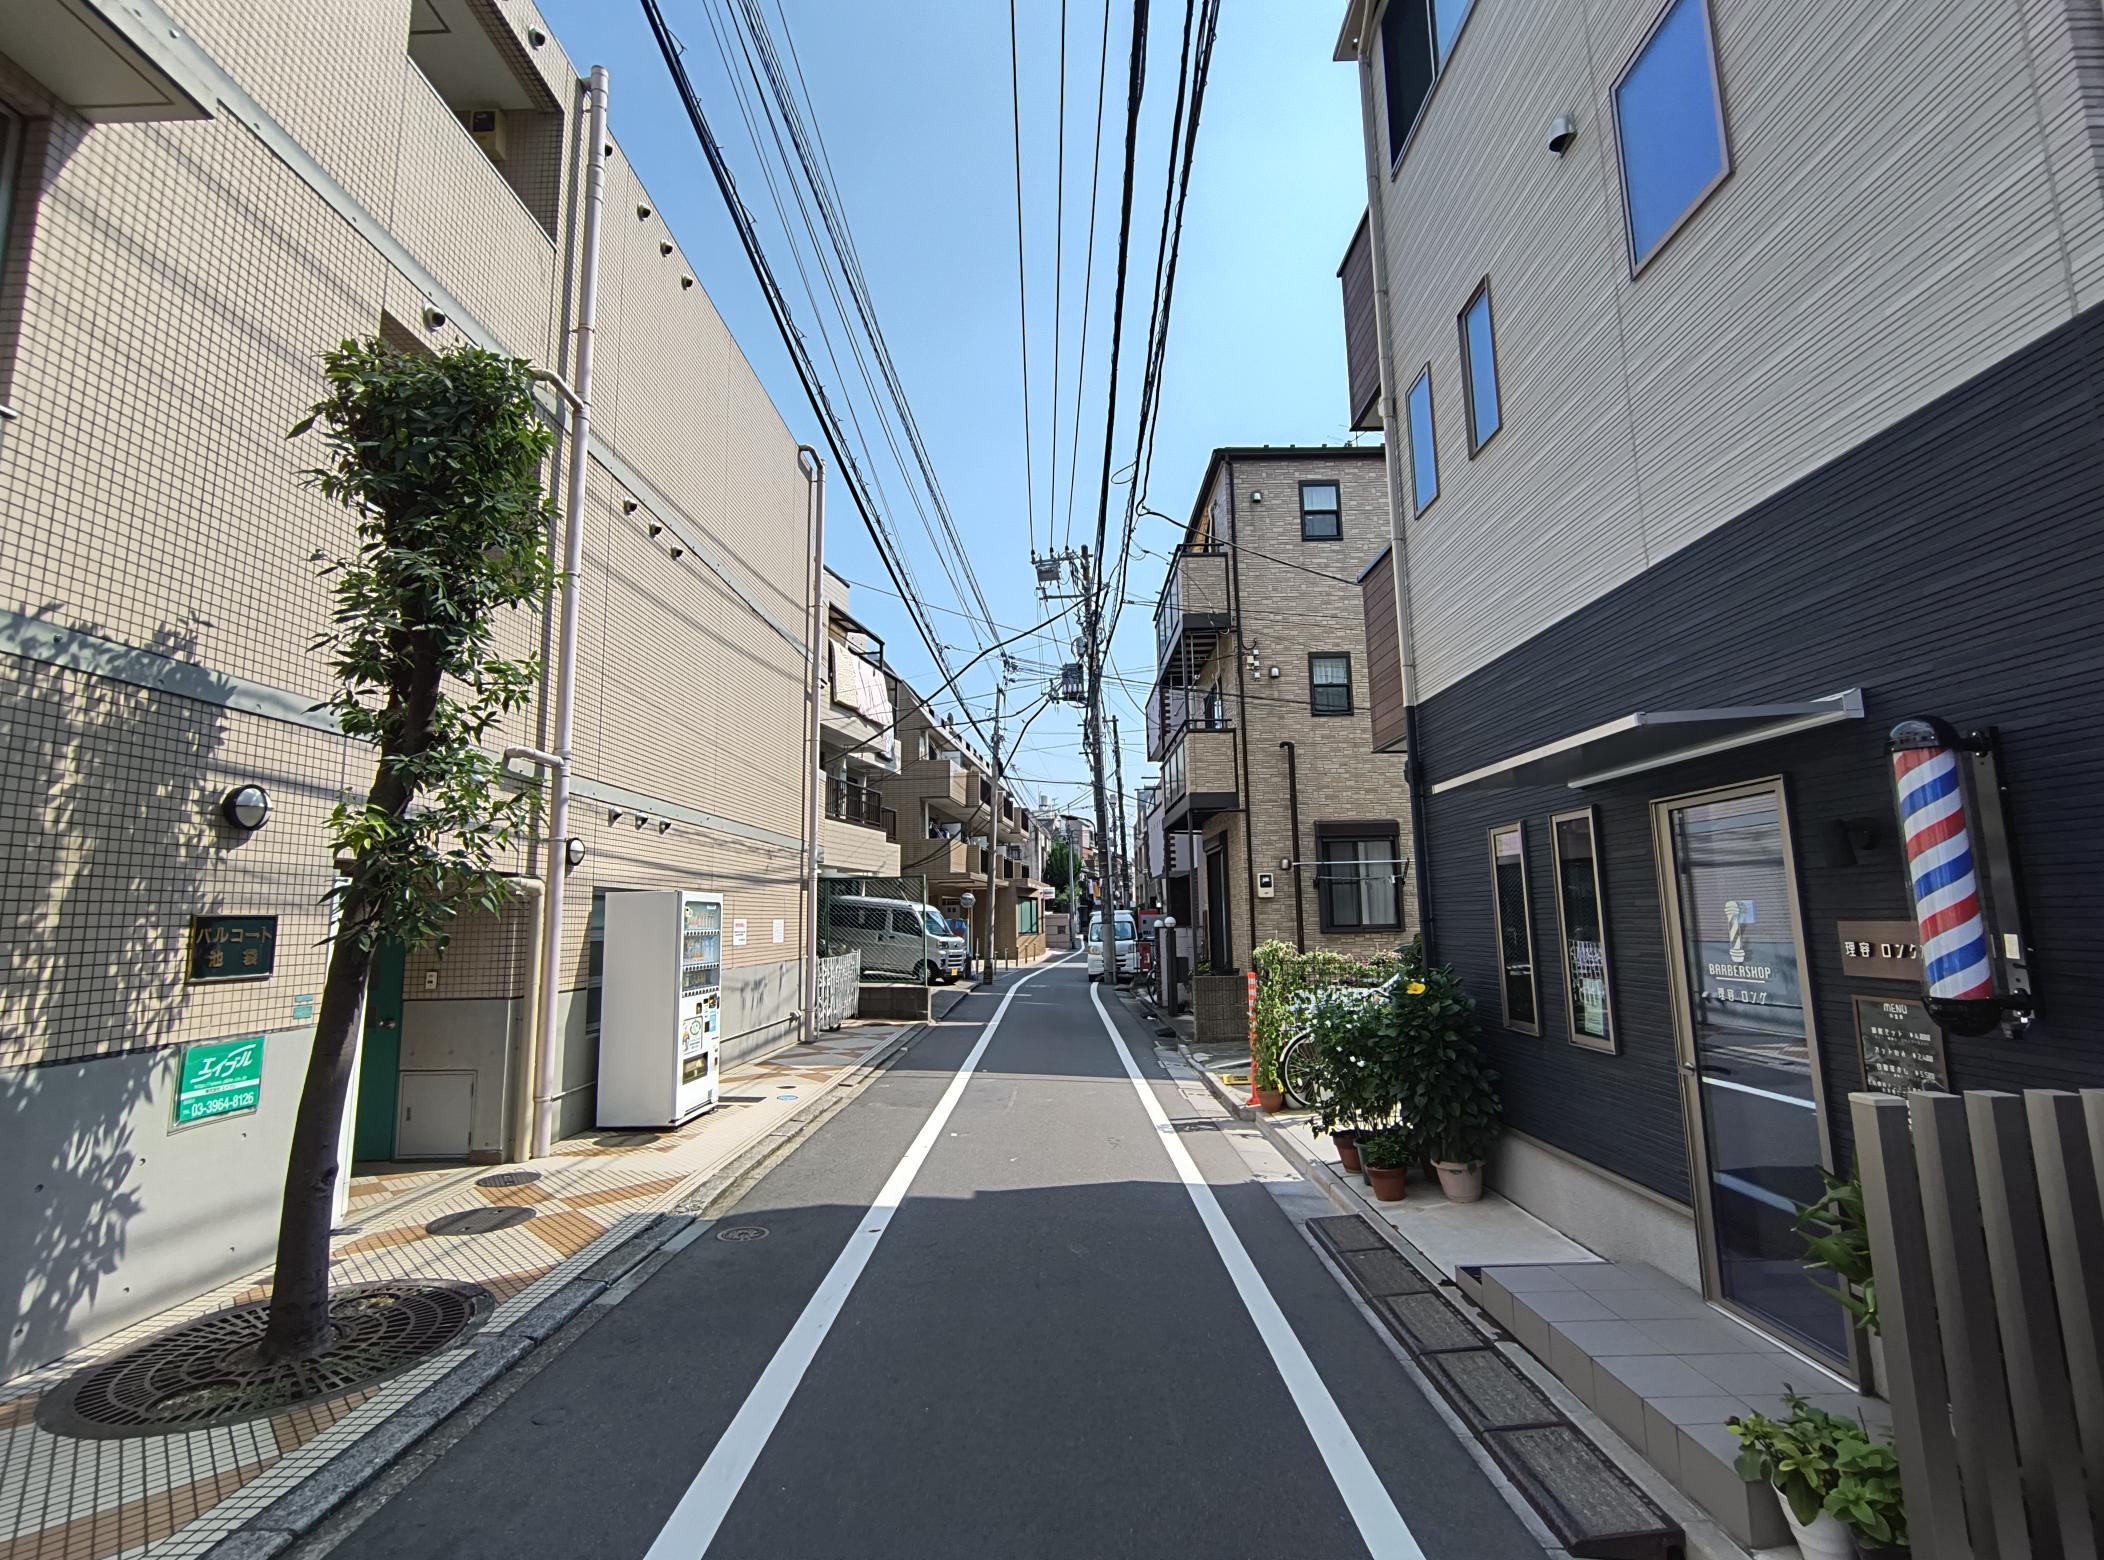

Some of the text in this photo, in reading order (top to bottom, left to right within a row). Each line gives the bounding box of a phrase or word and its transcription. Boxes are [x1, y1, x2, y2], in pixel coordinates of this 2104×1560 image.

[1844, 941, 1870, 957] 理容
[1709, 963, 1771, 979] BARBERSHOP
[1883, 1002, 1908, 1014] MENU
[190, 1043, 256, 1084] エイブル
[191, 1091, 255, 1117] 03-3964-8126
